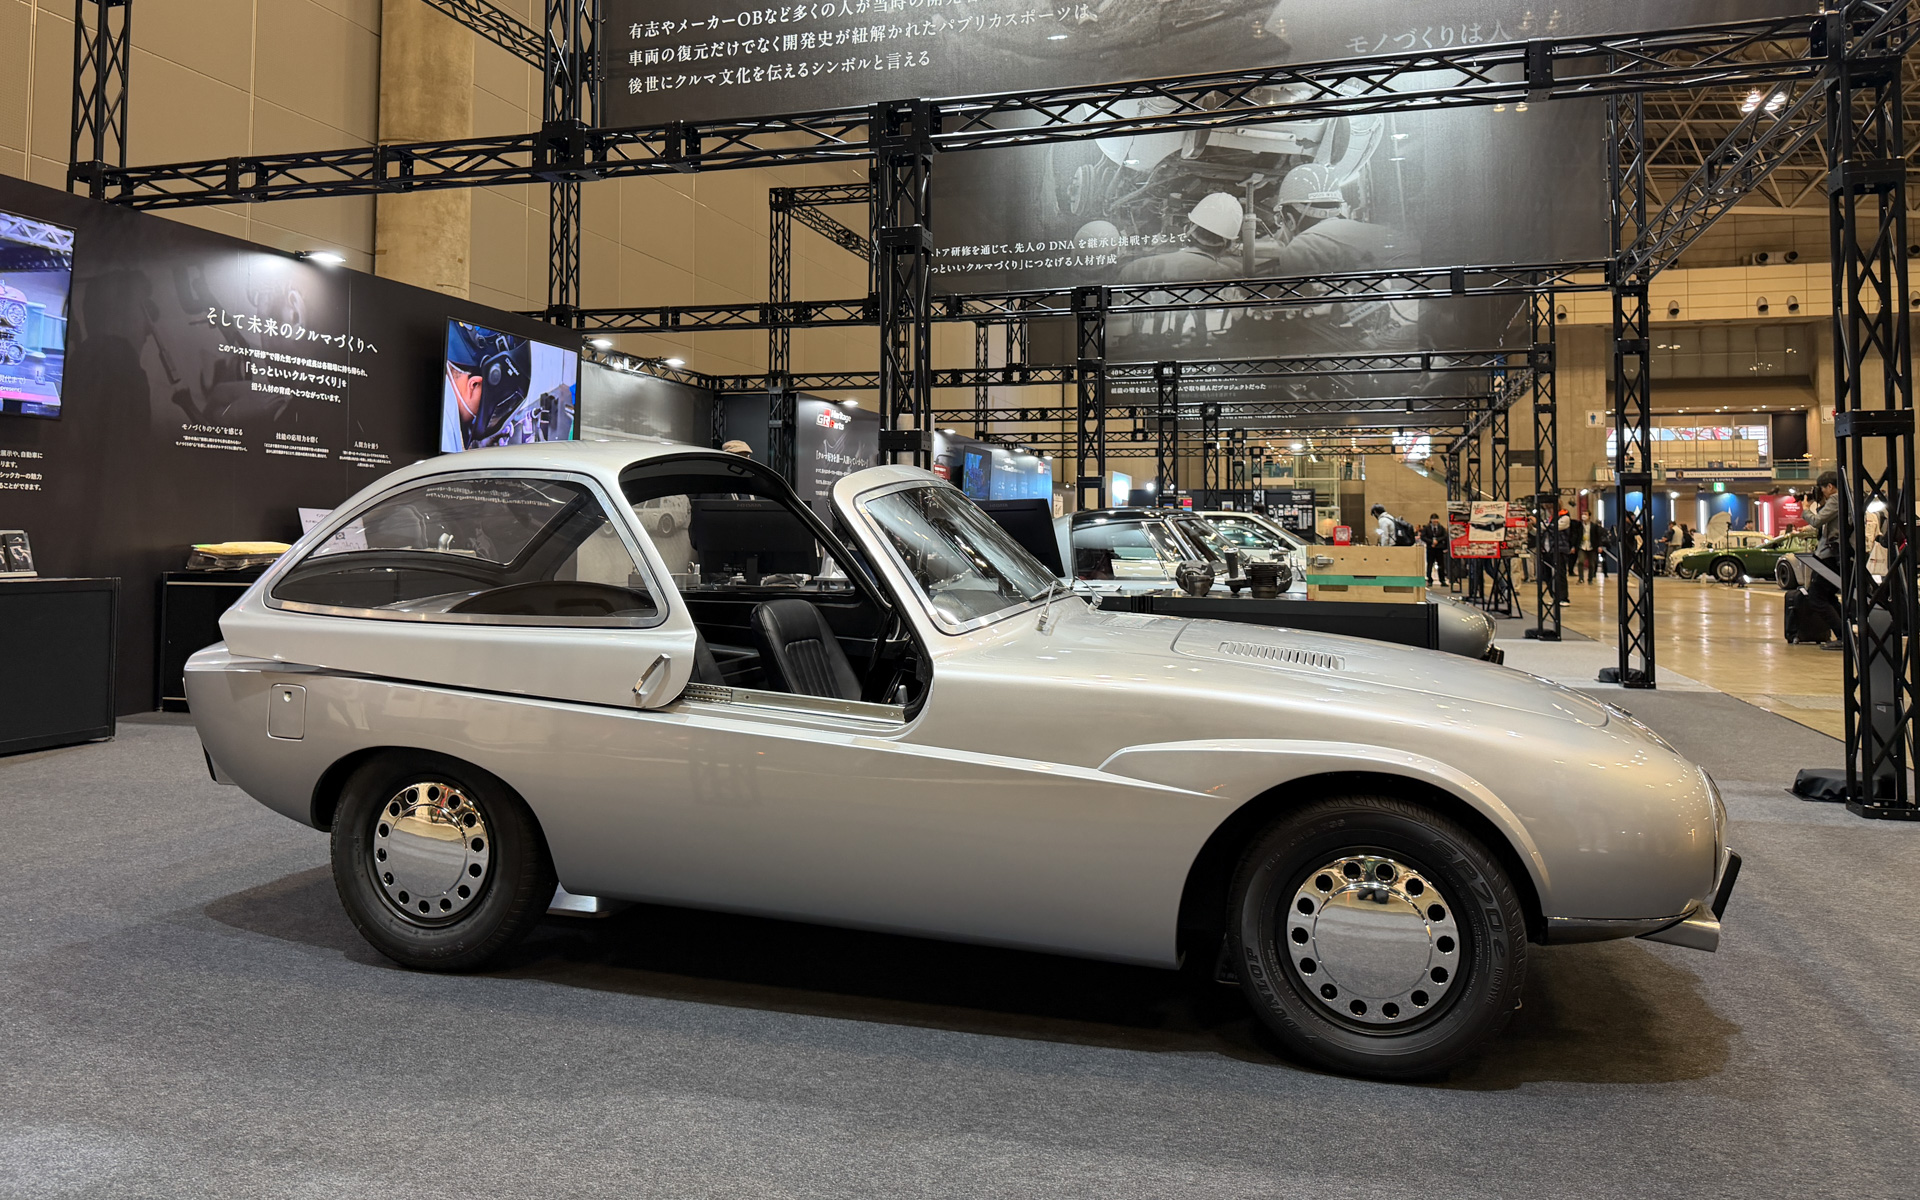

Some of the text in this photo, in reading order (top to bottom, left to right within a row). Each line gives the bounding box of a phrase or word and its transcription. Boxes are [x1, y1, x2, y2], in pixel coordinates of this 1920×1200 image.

[628, 48, 931, 95] 後世にクルマ文化を伝えるシンボルと言える
[1049, 240, 1076, 251] DNA
[1078, 233, 1193, 249] を継承し挑戦することで、
[930, 254, 1118, 274] っといいクルマづくり」につなげる人材育成
[207, 306, 378, 355] そして未来のクルマづくりへ
[245, 362, 348, 389] 「もっといいクルマづくり」を
[251, 382, 341, 404] 担う人材の育成へとつながっています。
